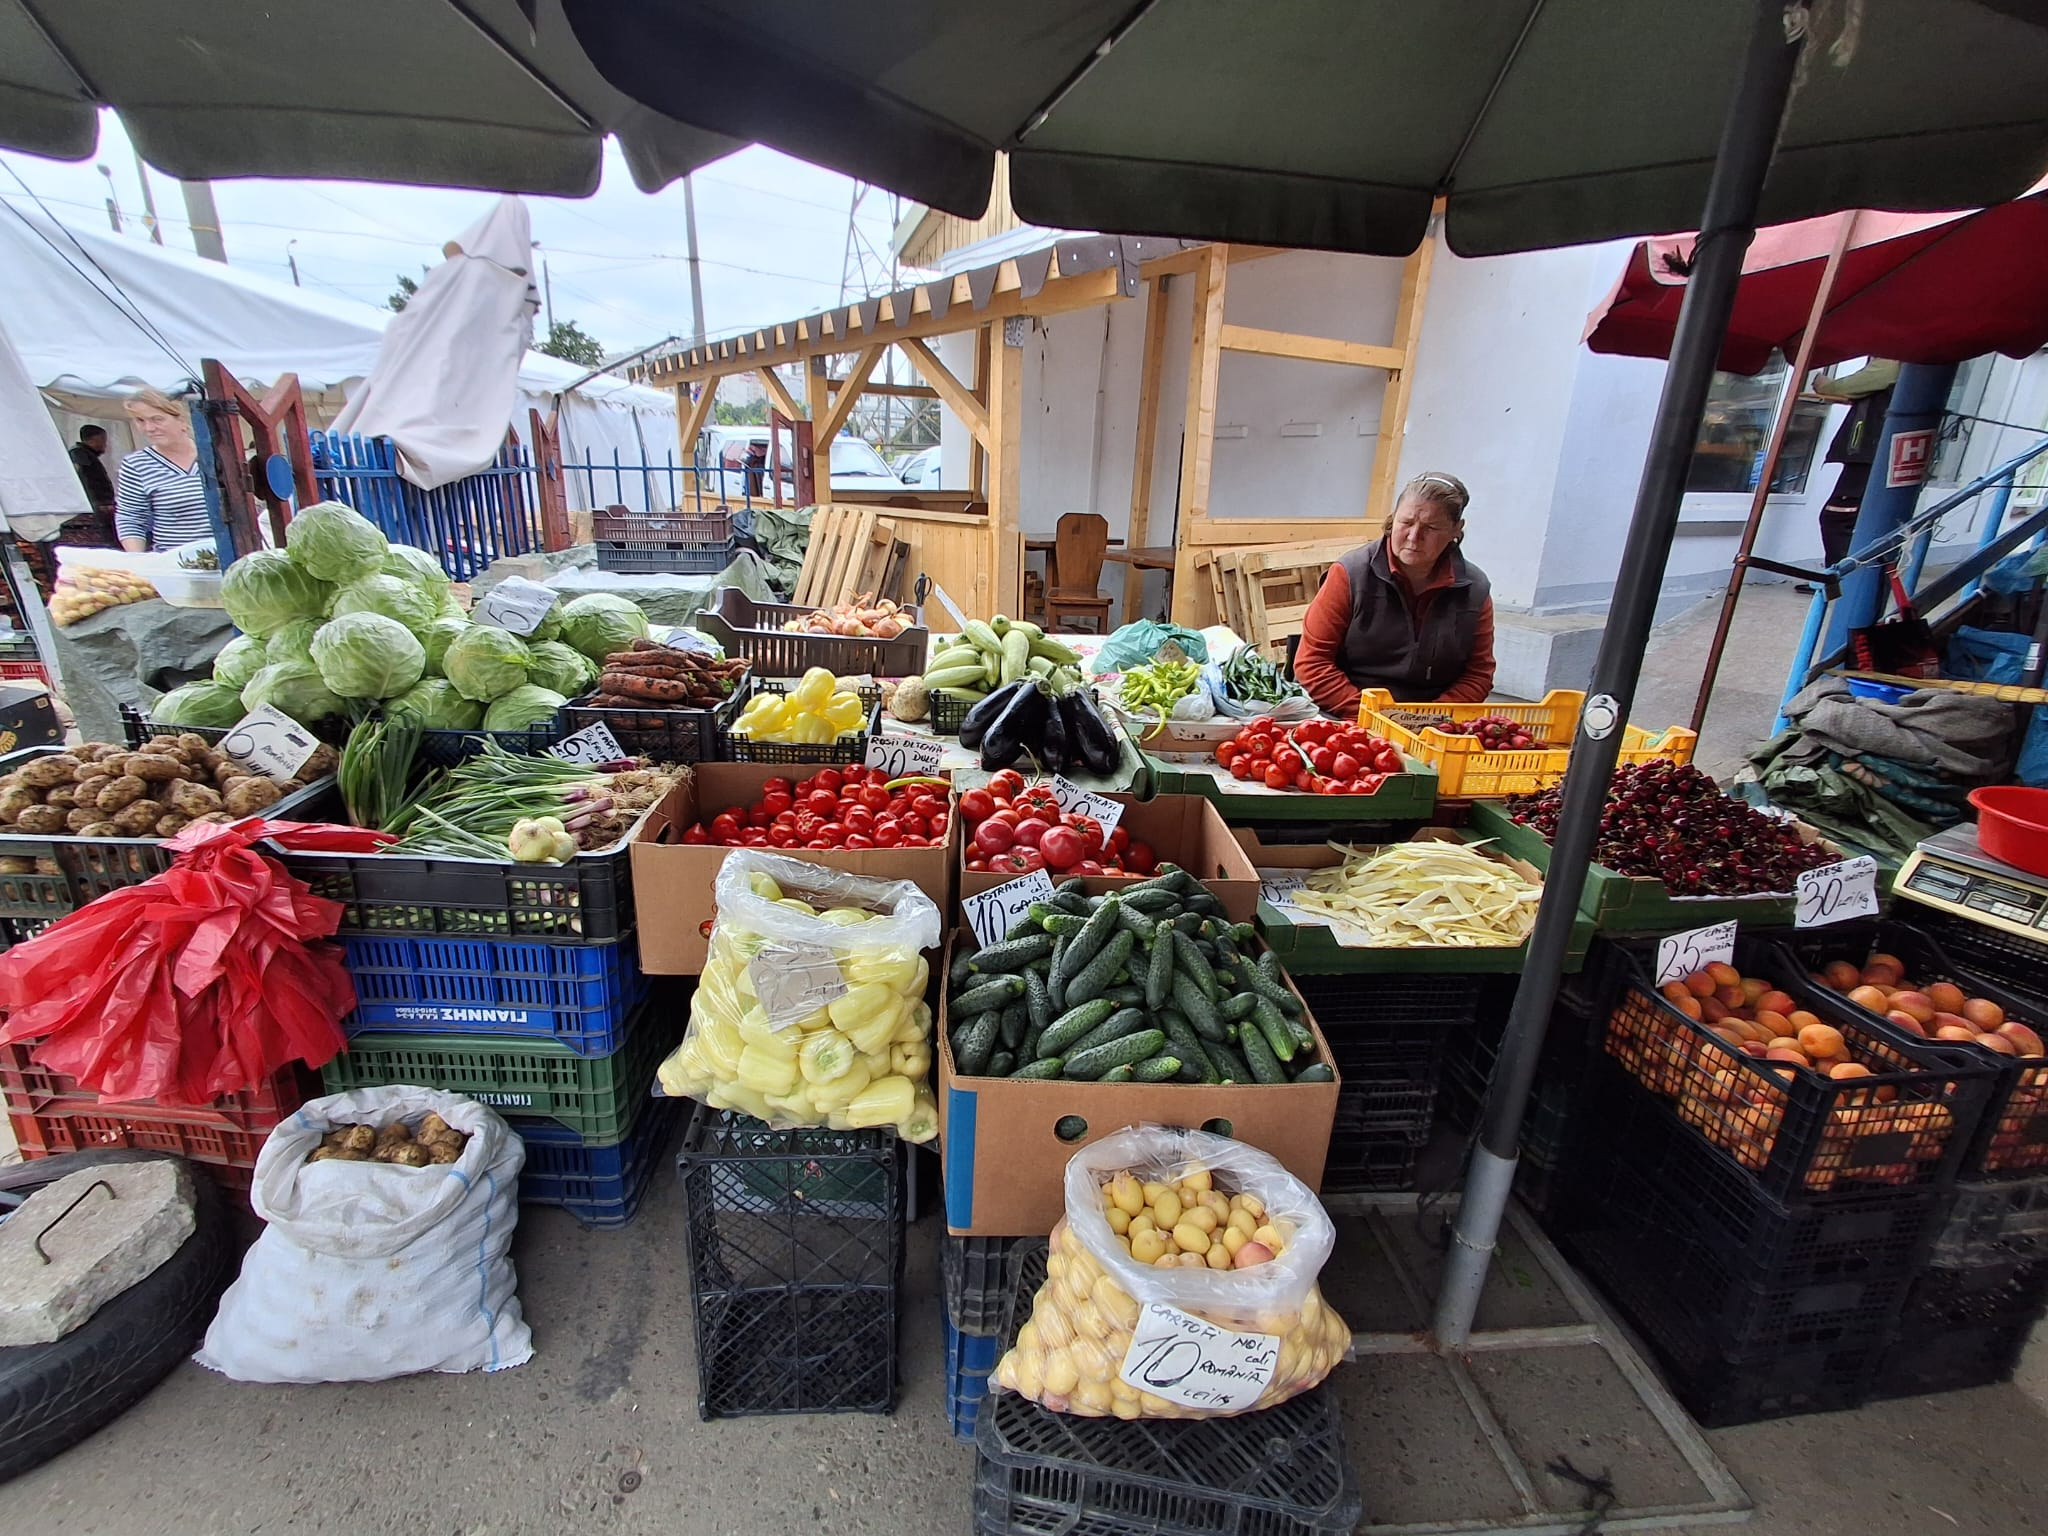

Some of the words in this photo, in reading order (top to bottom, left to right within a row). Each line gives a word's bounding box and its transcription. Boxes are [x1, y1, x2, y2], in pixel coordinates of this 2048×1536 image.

[1903, 439, 1926, 461] H
[488, 602, 531, 630] 5
[224, 721, 277, 760] 6
[563, 738, 590, 757] 6
[872, 746, 906, 780] 20
[1800, 878, 1843, 923] 30
[975, 899, 1007, 947] 10
[1656, 928, 1710, 985] 25
[440, 1007, 528, 1023] ΓΙΑΝΝΗΣ
[1129, 1333, 1202, 1388] 10
